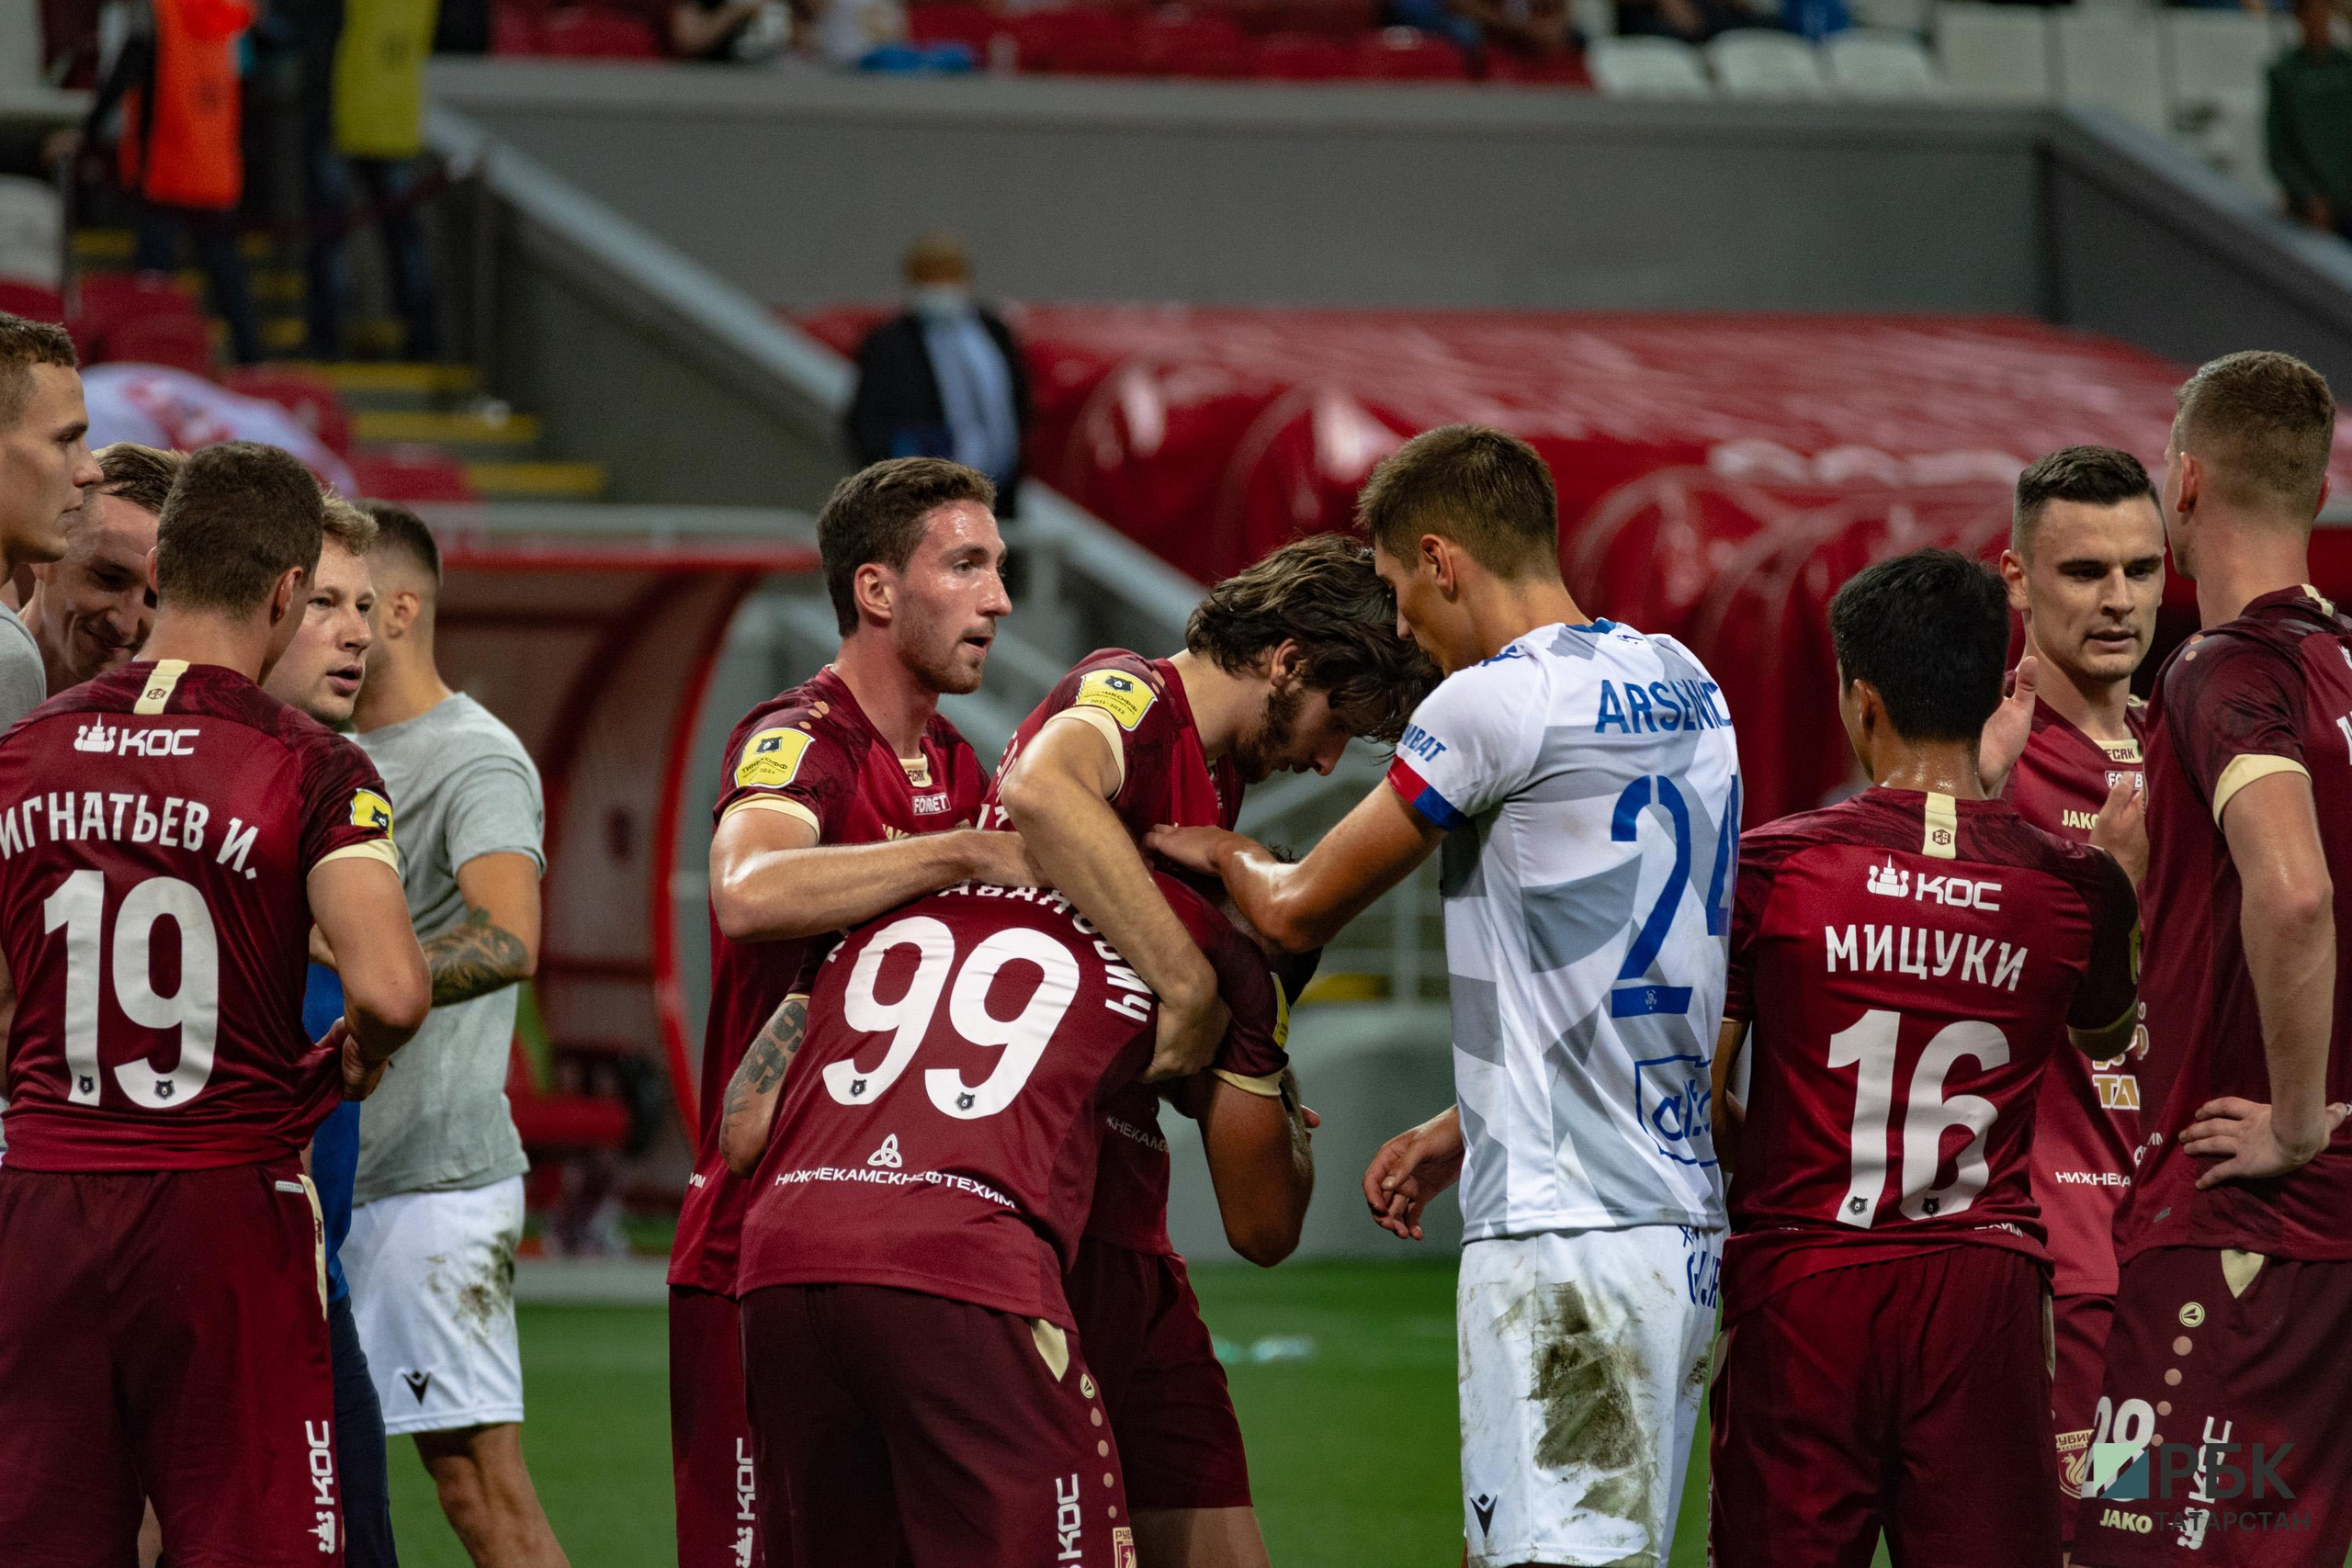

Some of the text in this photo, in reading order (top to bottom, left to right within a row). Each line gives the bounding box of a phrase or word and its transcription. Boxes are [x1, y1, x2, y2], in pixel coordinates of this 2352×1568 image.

[118, 728, 200, 757] КОС
[0, 791, 259, 880] ИГНАТЬЕВ И.
[1916, 874, 2003, 911] КОС
[43, 868, 219, 1110] 19
[1825, 923, 2028, 992] МИЦУКИ
[822, 915, 1080, 1120] 99
[1827, 1009, 2010, 1230] 16
[2100, 1508, 2153, 1534] JAKO
